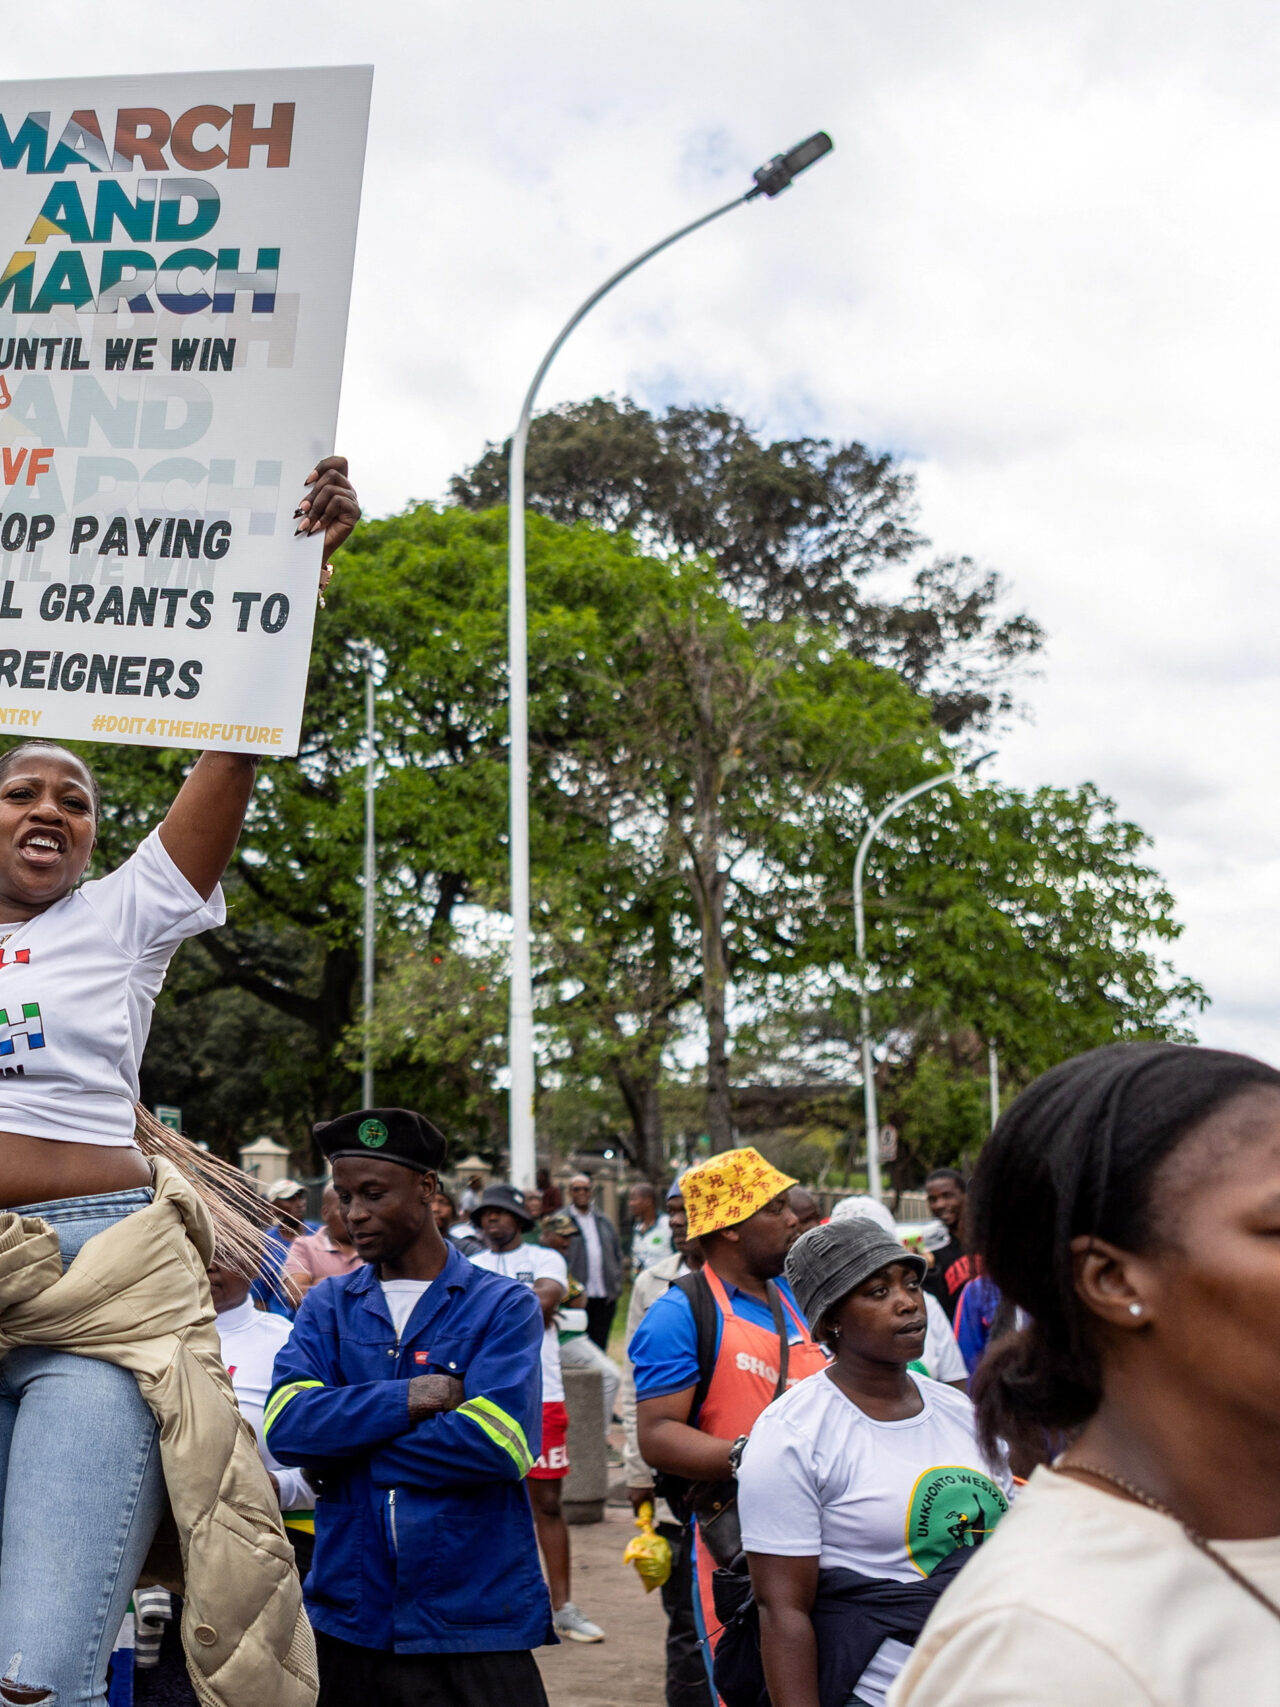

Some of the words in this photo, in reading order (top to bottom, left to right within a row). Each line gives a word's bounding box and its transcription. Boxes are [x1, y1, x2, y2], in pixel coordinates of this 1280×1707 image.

[25, 177, 221, 244] AND
[104, 338, 158, 372] WE
[170, 338, 237, 372] WIN
[69, 515, 232, 560] PAYING
[39, 583, 213, 630] GRANTS
[232, 591, 290, 634] TO
[92, 714, 283, 745] #DOIT4THEIRFUTURE
[918, 1475, 956, 1537] UMKHONTO
[957, 1475, 1008, 1512] WESIZW
